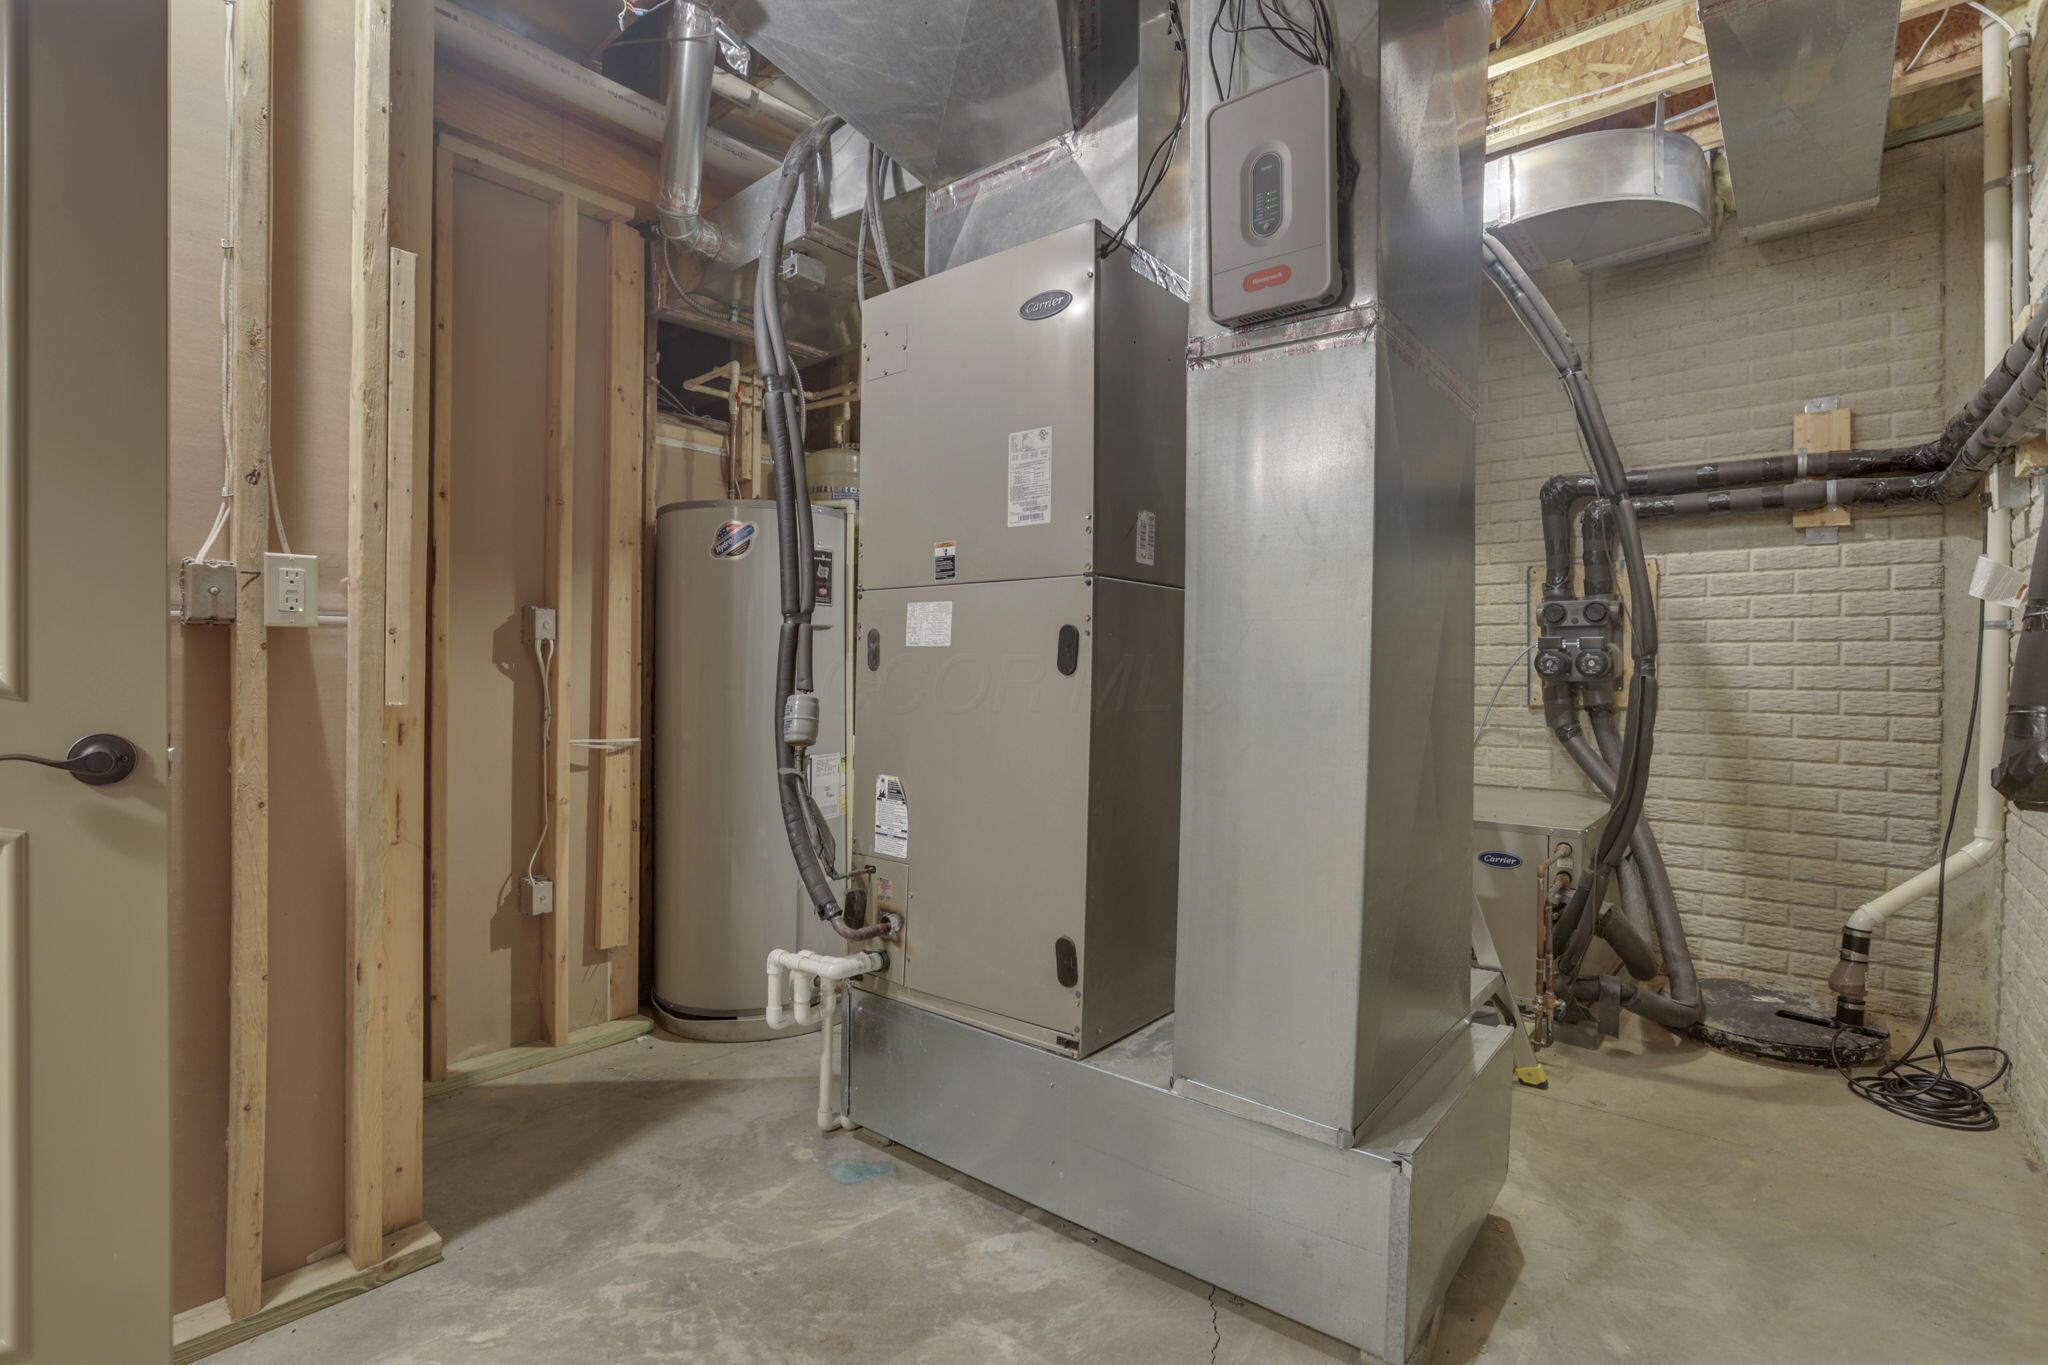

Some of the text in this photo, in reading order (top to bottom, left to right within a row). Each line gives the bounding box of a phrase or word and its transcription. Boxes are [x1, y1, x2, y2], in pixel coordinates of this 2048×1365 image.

[1252, 271, 1283, 286] Honeywell
[1025, 295, 1065, 315] Carrier
[1483, 853, 1518, 866] Carrier
